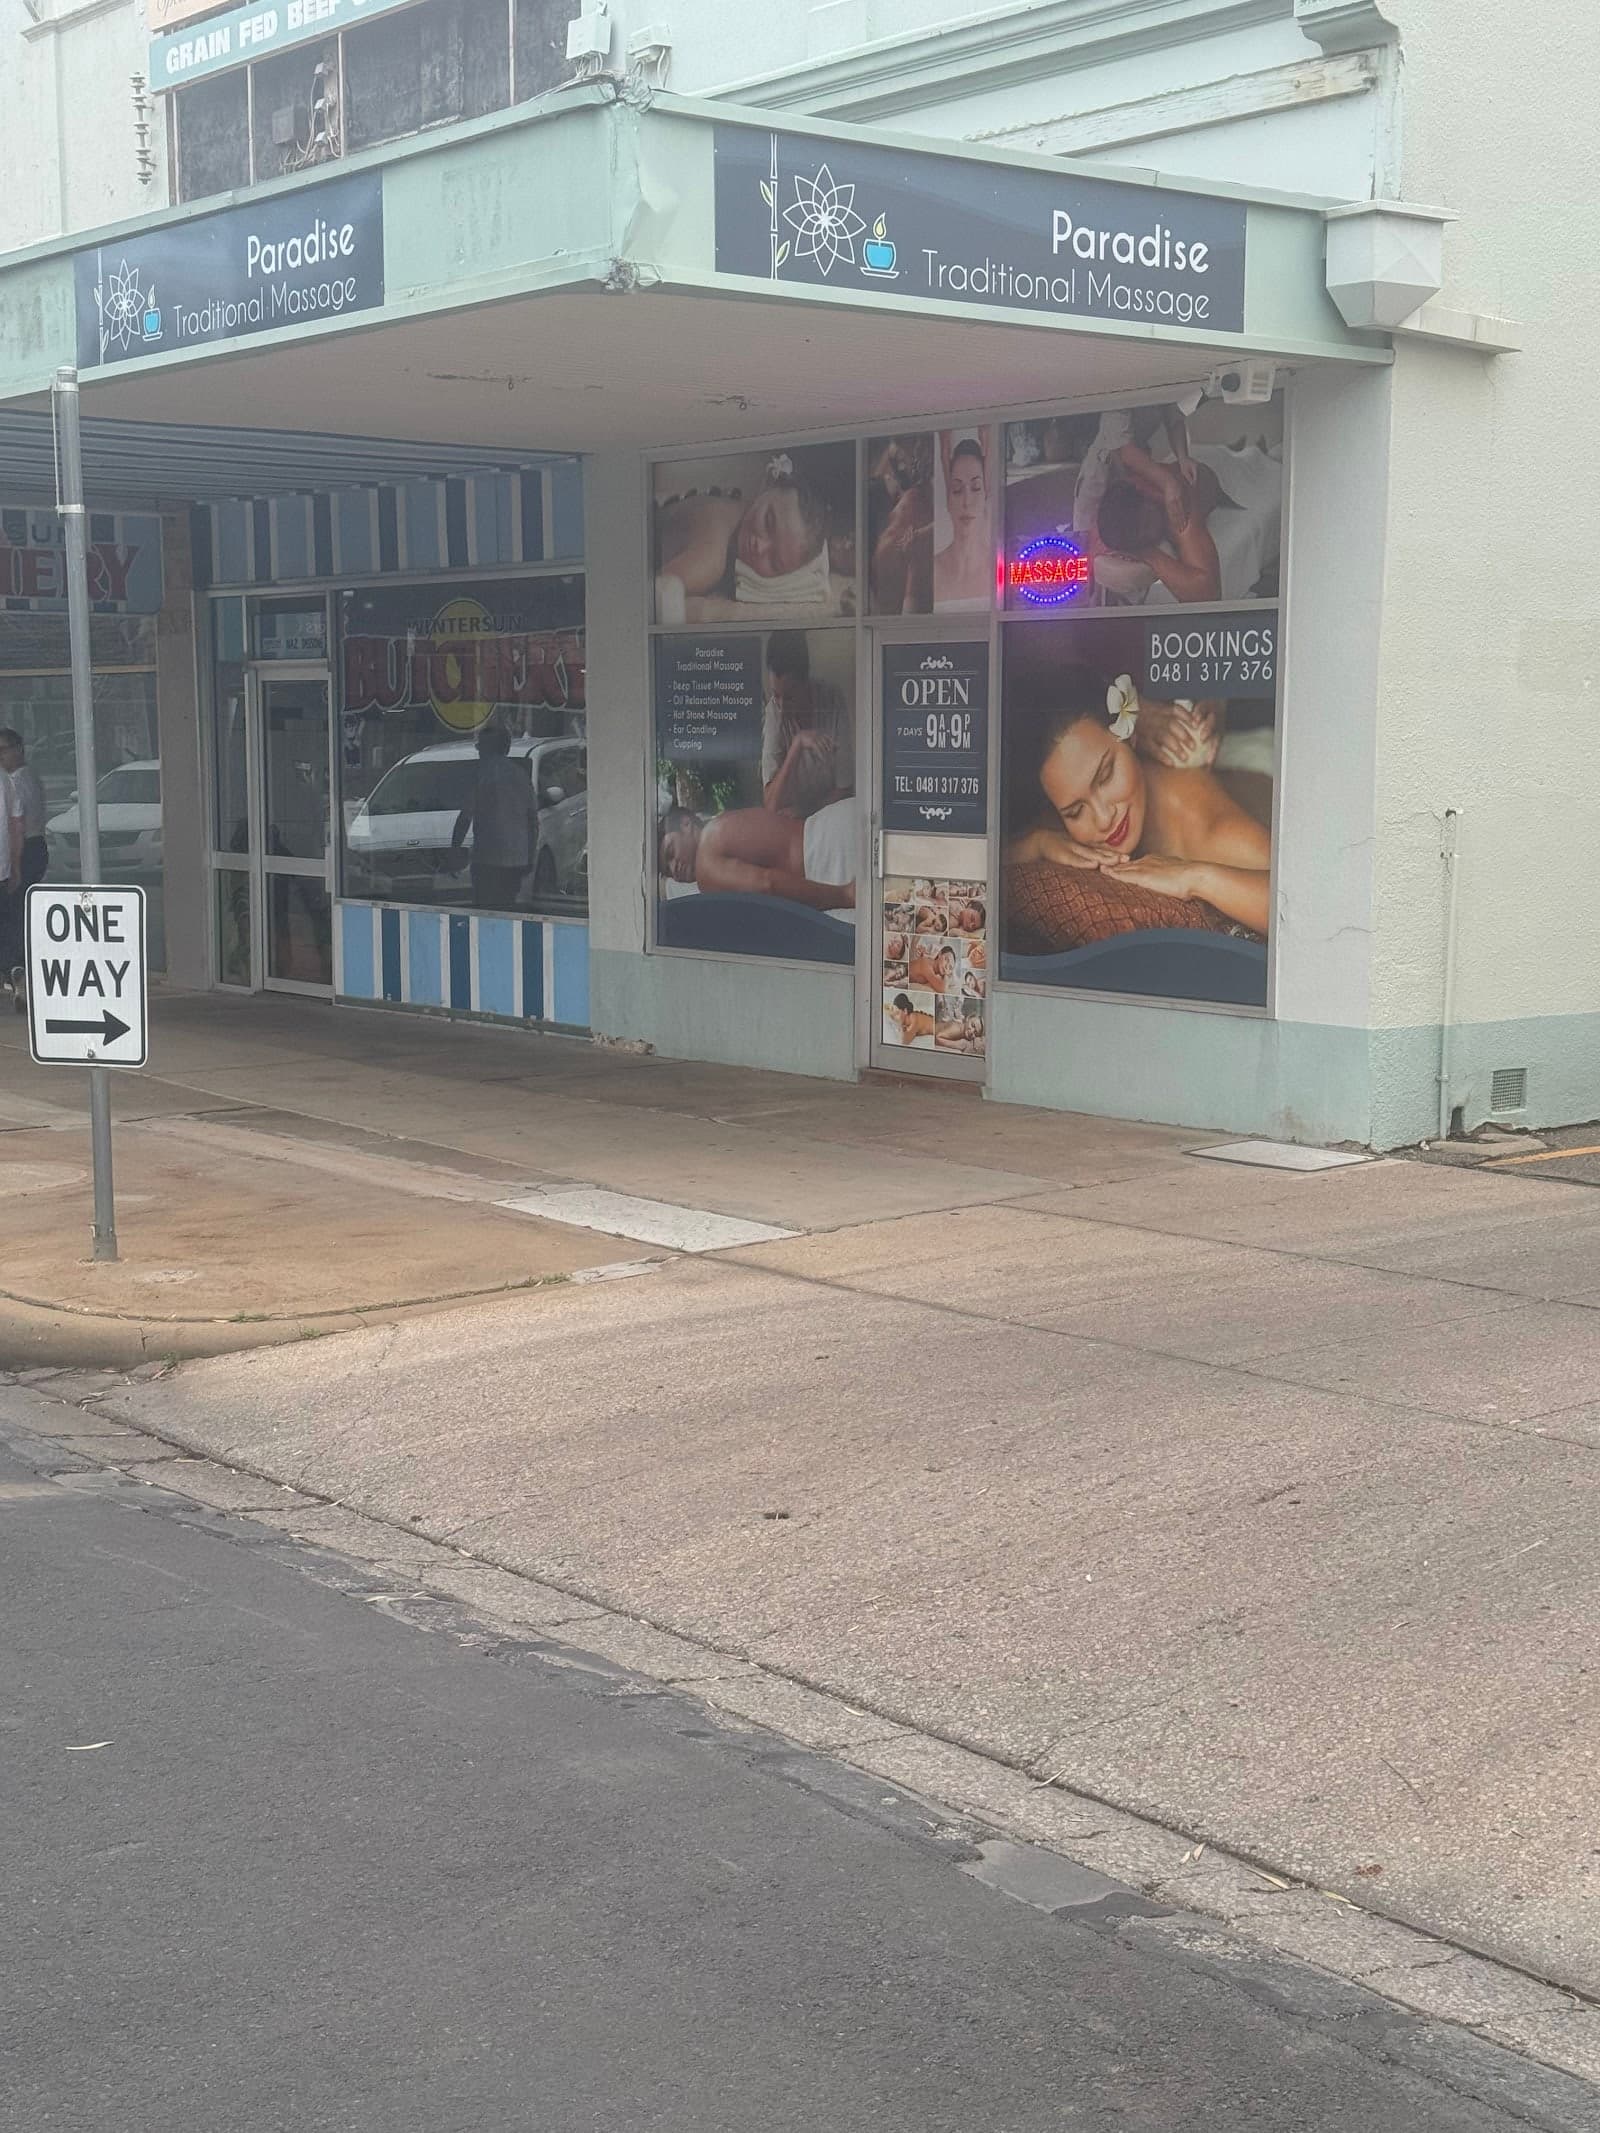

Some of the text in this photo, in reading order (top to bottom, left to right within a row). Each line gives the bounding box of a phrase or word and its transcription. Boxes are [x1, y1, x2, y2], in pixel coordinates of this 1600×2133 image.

[166, 26, 231, 74] GRAIN
[239, 10, 278, 48] FED
[247, 218, 355, 278] Paradise
[1052, 209, 1210, 273] Paradise
[921, 248, 1211, 322] Traditional Massage
[173, 277, 357, 338] Traditional Massage
[1010, 557, 1088, 584] MASSAGE
[407, 615, 523, 634] WINTERSUN
[695, 647, 725, 657] Paradise
[1151, 629, 1274, 660] BOOKINGS
[676, 660, 744, 671] Traditional Massage
[1150, 660, 1273, 682] 0481 317 376
[673, 680, 744, 692] Deep Tissue Massage
[901, 678, 971, 705] OPEN
[722, 695, 753, 707] Massage
[673, 709, 737, 721] Hot Stone Massage
[673, 724, 685, 735] Ear
[903, 727, 923, 737] DAYS
[673, 738, 703, 751] Cupping
[895, 775, 979, 795] TEL: 0481 317 376
[46, 903, 125, 943] ONE
[41, 959, 131, 998] WAY
